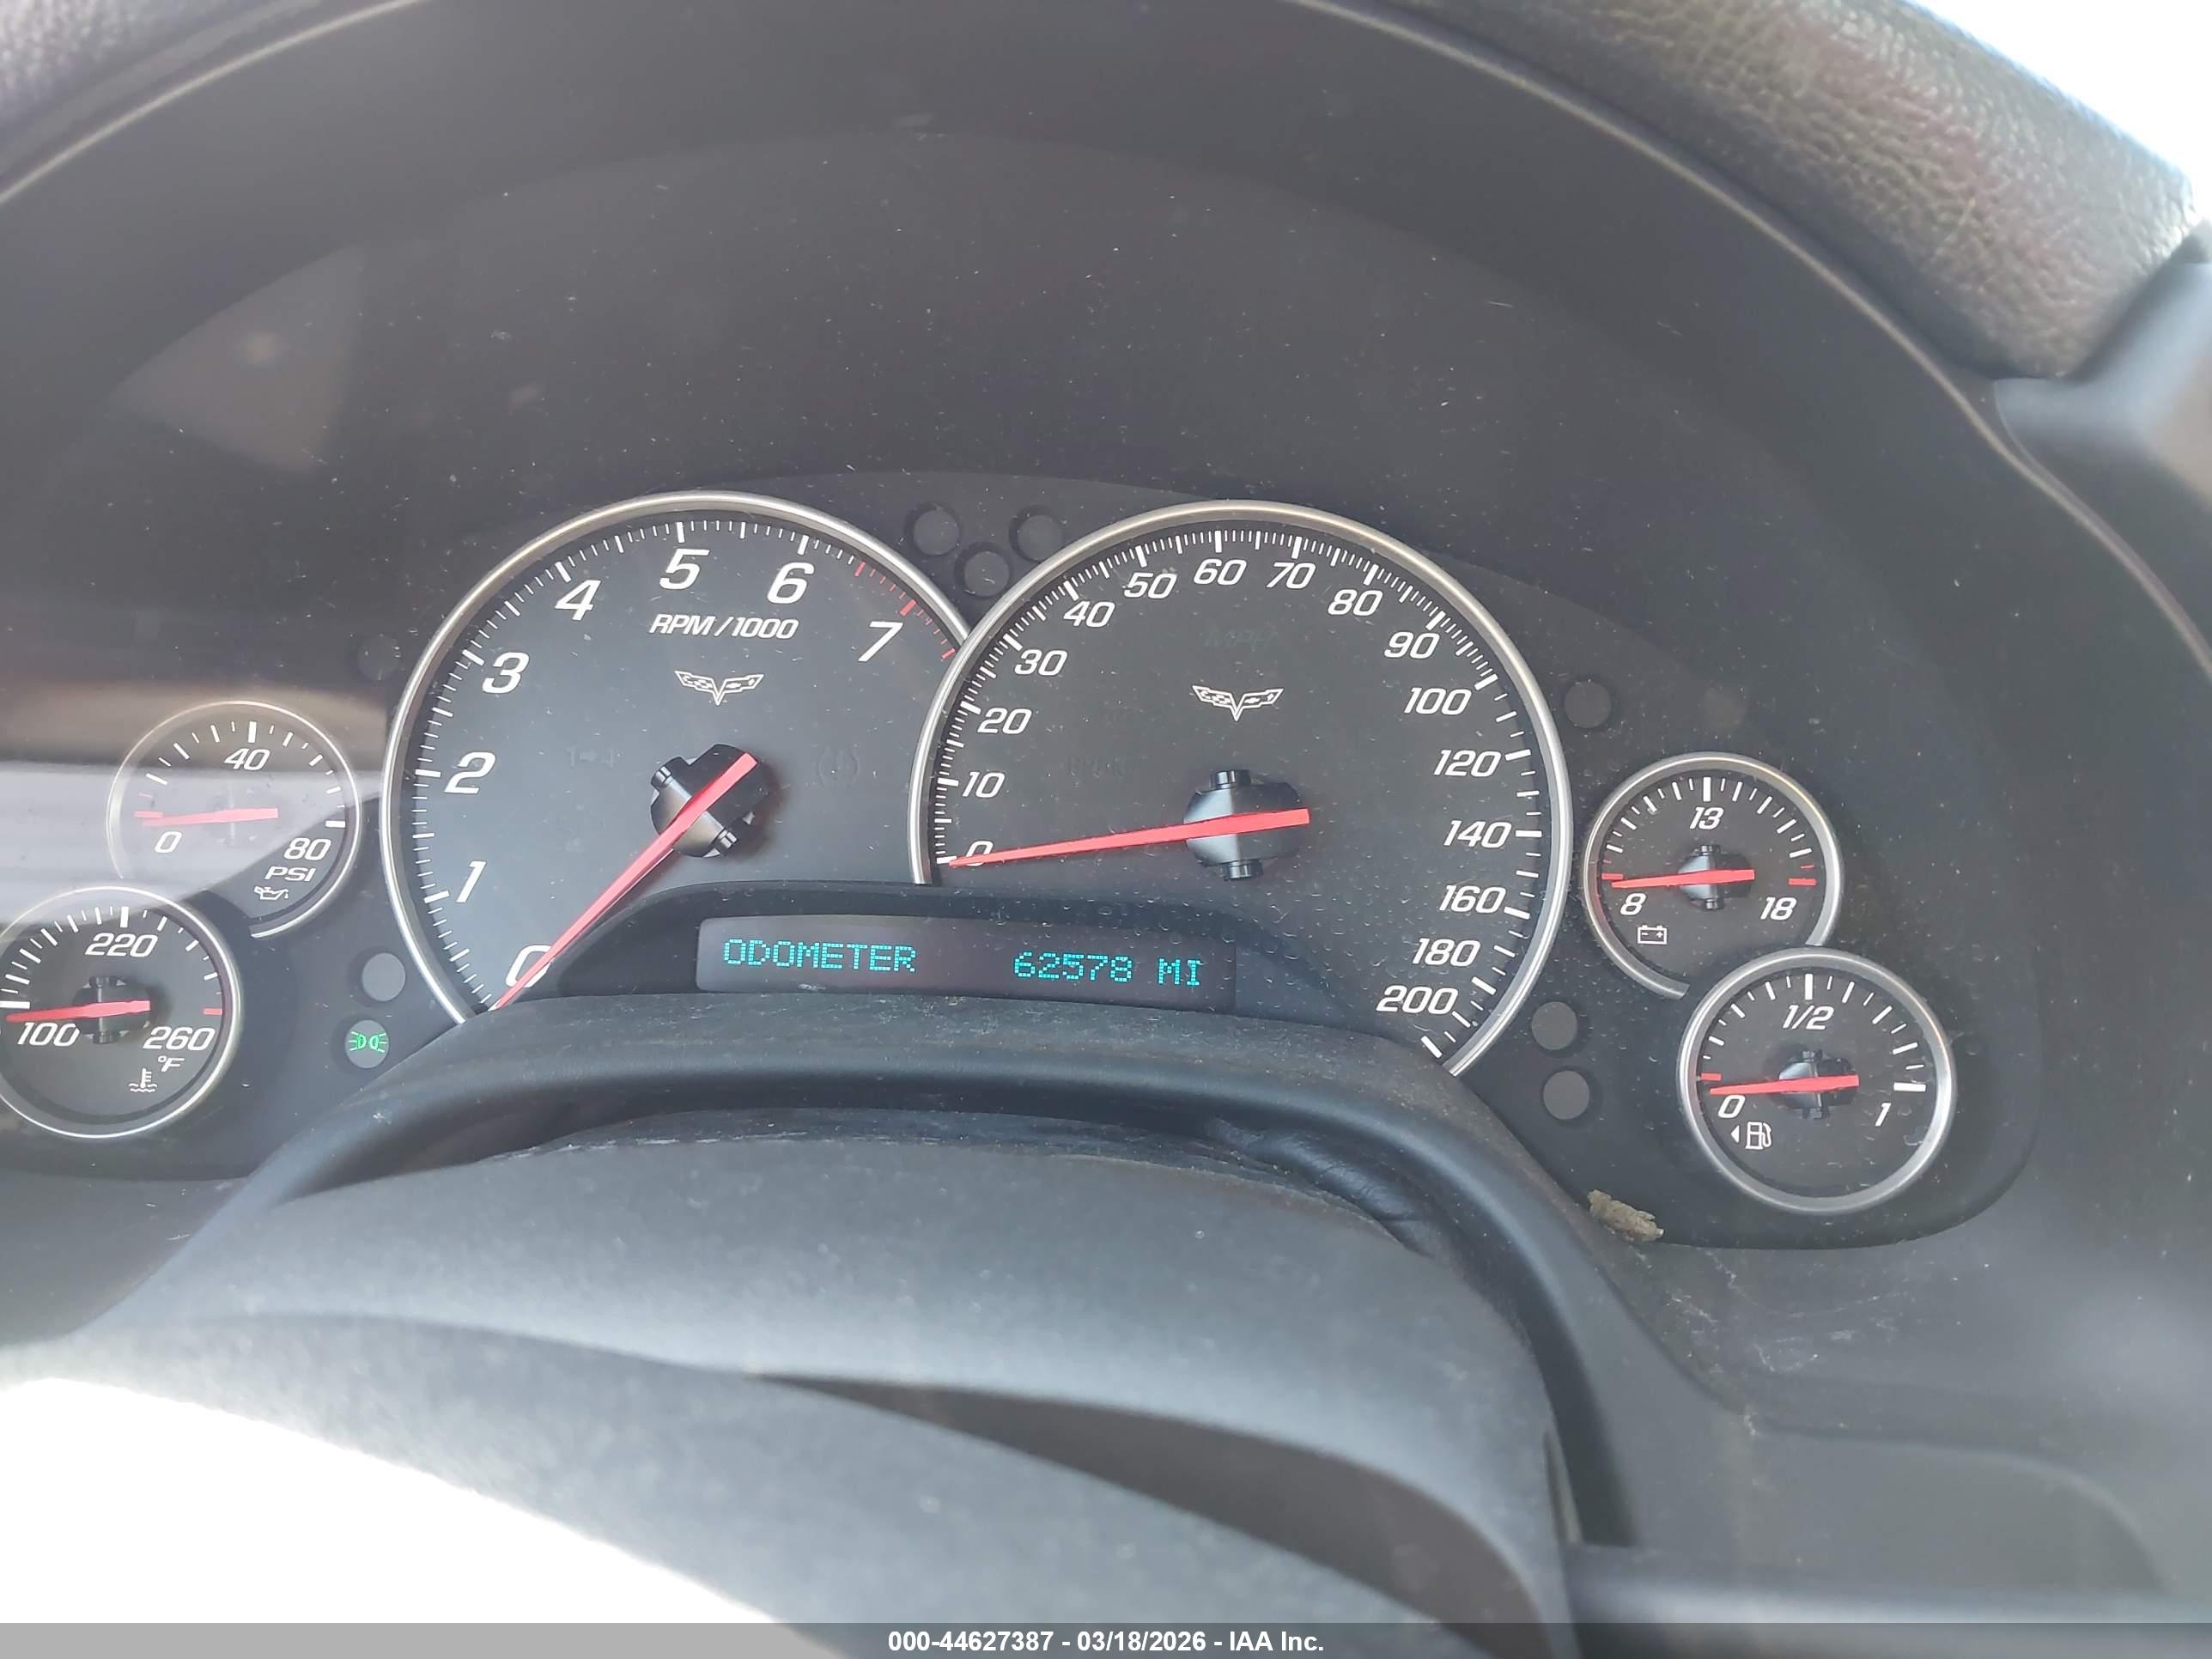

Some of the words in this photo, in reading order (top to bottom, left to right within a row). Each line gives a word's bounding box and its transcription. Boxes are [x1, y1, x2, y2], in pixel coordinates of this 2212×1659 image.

[659, 548, 710, 590] 5
[1193, 558, 1247, 586] 60
[1267, 562, 1316, 589] 70
[767, 562, 815, 605] 6
[1124, 572, 1177, 599] 50
[555, 579, 601, 621] 4
[1063, 600, 1115, 628] 40
[1328, 589, 1383, 617] 80
[858, 621, 903, 662] 7
[1383, 631, 1439, 659] 90
[480, 652, 530, 694] 3
[1013, 648, 1068, 676] 30
[1404, 687, 1472, 715] 100
[977, 706, 1032, 734] 20
[223, 748, 270, 770] 40
[444, 751, 496, 794] 2
[1433, 750, 1502, 777] 120
[962, 771, 1006, 798] 10
[1689, 806, 1724, 830] 13
[155, 831, 183, 854] 0
[1443, 820, 1512, 848] 140
[283, 837, 331, 860] 80
[264, 866, 317, 882] PSI
[456, 860, 486, 903] 1
[1439, 884, 1506, 912] 160
[1620, 892, 1647, 915] 8
[1760, 896, 1797, 921] 18
[84, 933, 159, 957] 220
[1413, 938, 1481, 967] 180
[722, 937, 918, 972] ODOMETER
[1012, 949, 1135, 984] 62578
[1156, 957, 1201, 988] MI
[1376, 985, 1457, 1016] 200
[1783, 1005, 1834, 1030] 1/2
[17, 1022, 80, 1047] 100
[143, 1026, 216, 1051] 260
[157, 1055, 185, 1073] °F
[1717, 1094, 1746, 1119] 0
[1875, 1103, 1892, 1127] 1
